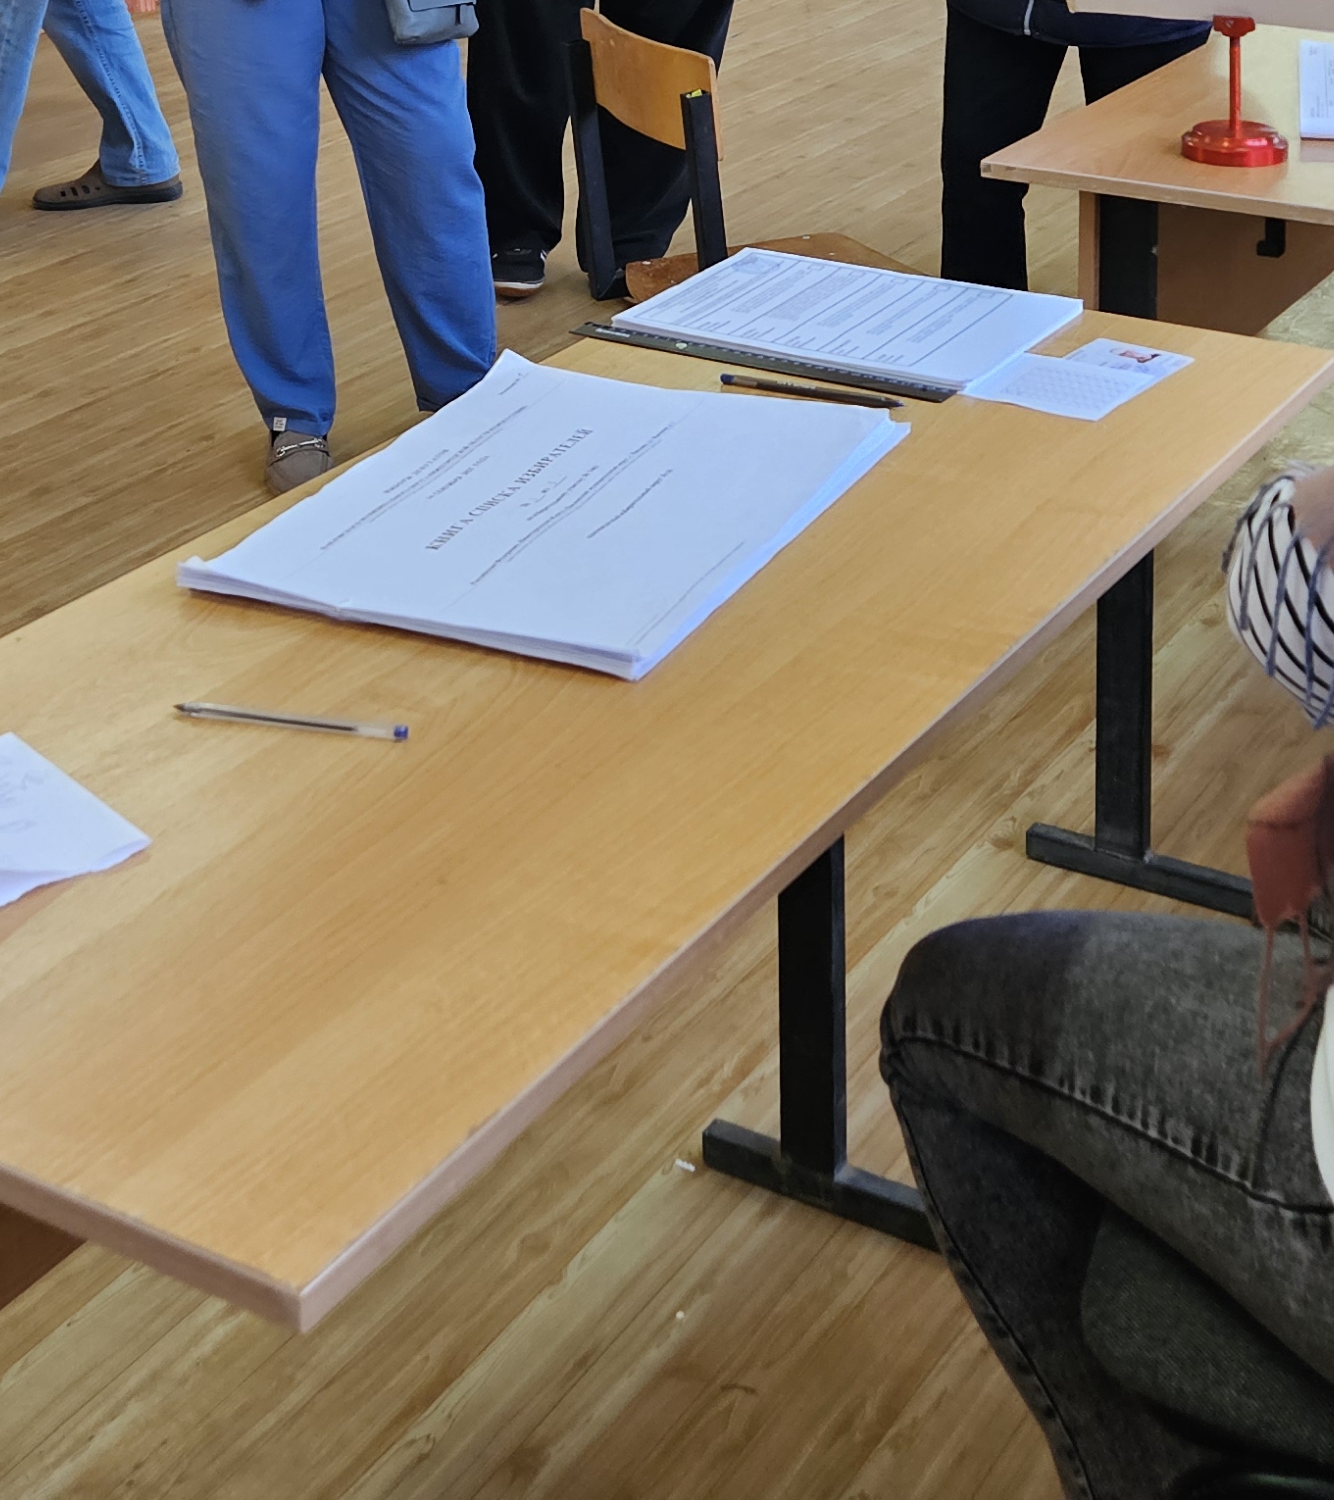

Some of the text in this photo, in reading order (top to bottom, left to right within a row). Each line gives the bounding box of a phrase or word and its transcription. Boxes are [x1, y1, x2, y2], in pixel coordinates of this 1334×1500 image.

[426, 517, 473, 551] КНИГА
[469, 486, 521, 518] СПИСКА
[515, 428, 594, 485] ИЗБИРАТЕЛЕЙ
